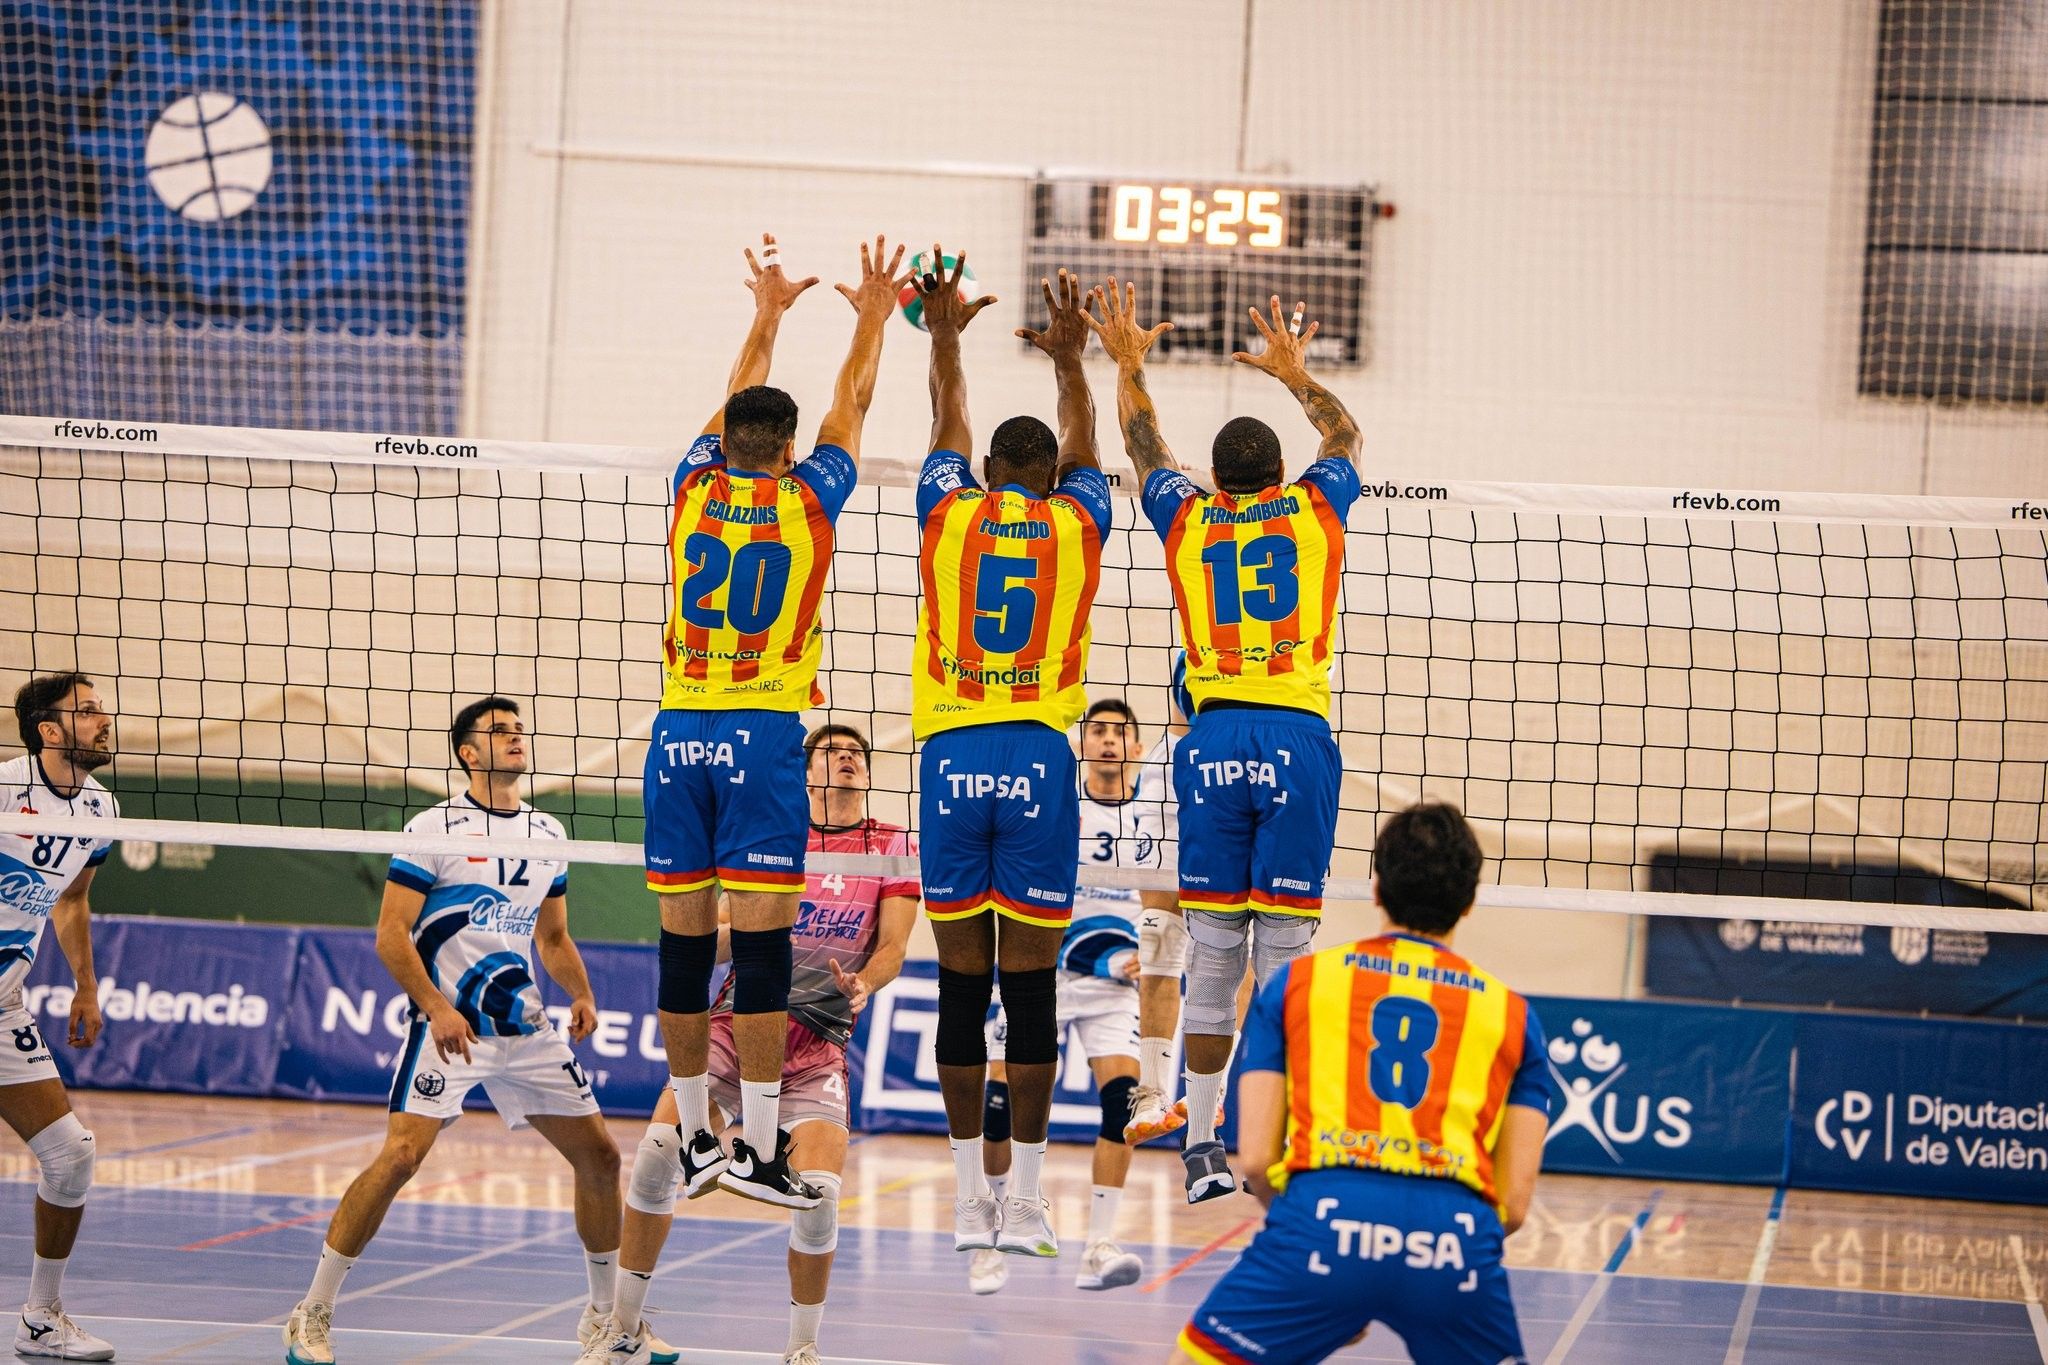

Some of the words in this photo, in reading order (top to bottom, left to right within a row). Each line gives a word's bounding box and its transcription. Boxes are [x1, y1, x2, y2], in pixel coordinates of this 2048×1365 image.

[1113, 185, 1283, 247] 03:25
[54, 420, 158, 442] rfevb.com
[375, 437, 478, 458] rfevb.com
[1360, 481, 1447, 500] evb.com
[1672, 491, 1780, 512] rfevb.com
[705, 498, 778, 525] CALAZANS
[1201, 495, 1300, 525] PERNAMBUCO
[979, 517, 1051, 540] FURTADO
[682, 531, 792, 635] 20
[1201, 533, 1299, 626] 13
[973, 552, 1038, 654] 5
[664, 741, 734, 767] TIPSA
[946, 774, 1031, 801] TIPSA
[1198, 760, 1277, 788] TIPSA
[32, 835, 74, 868] 87
[747, 852, 762, 864] BAR
[1092, 832, 1113, 861] 3
[821, 874, 846, 895] 4
[1027, 887, 1041, 899] BAR
[1344, 953, 1410, 976] PAULO
[1368, 995, 1440, 1111] 8
[822, 1072, 845, 1100] 4
[1907, 1094, 2048, 1134] Diputaci
[1905, 1134, 1950, 1166] de
[1329, 1218, 1465, 1270] TIPSA
